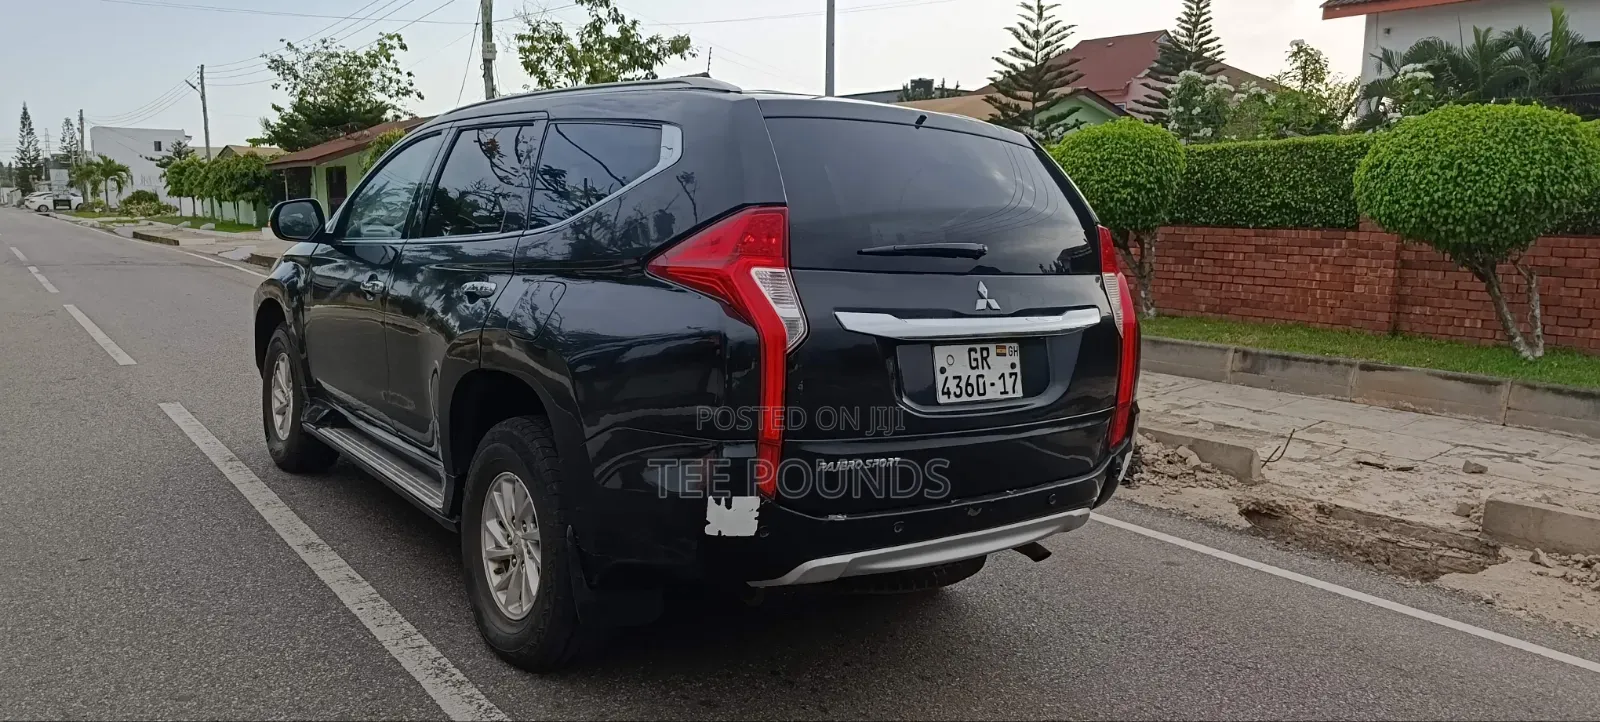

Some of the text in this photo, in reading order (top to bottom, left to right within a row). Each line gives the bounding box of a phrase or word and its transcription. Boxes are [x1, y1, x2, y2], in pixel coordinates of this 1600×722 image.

[967, 346, 991, 370] GR
[1008, 345, 1019, 357] GH
[941, 371, 1018, 400] 4360-17
[817, 457, 901, 472] PAJERO SPORT
